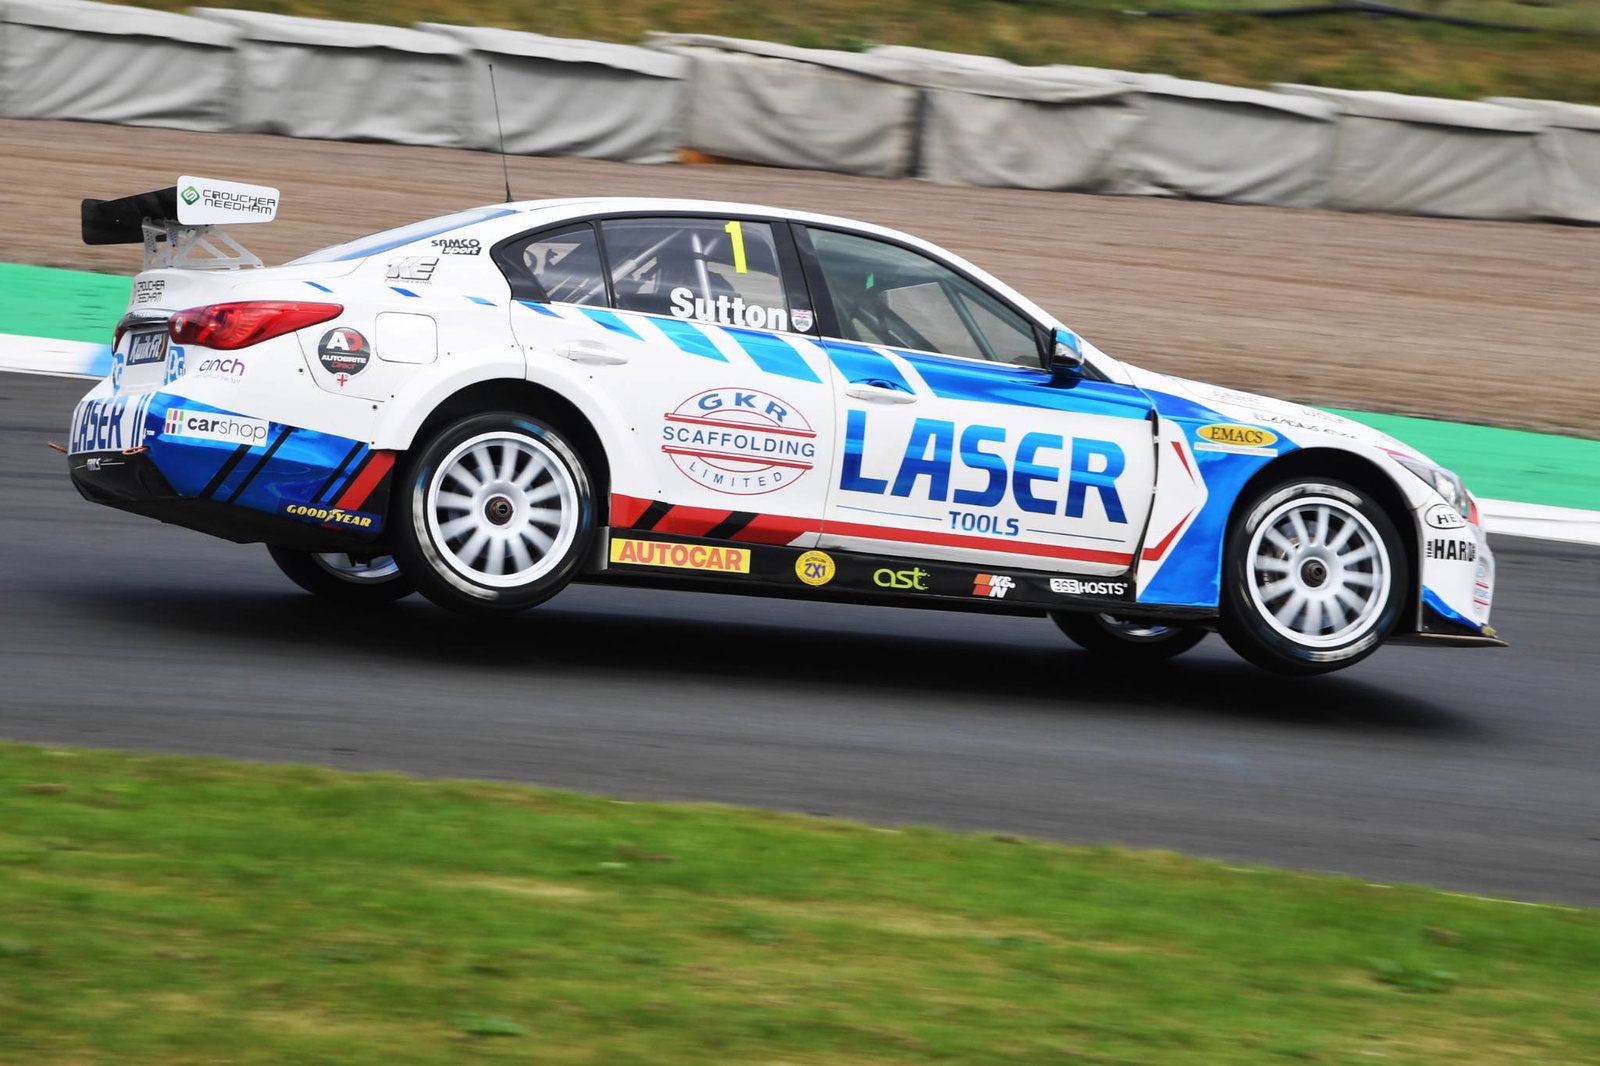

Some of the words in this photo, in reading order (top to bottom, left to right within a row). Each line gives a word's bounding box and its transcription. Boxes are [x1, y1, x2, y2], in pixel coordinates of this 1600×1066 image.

[202, 189, 276, 206] CROUCHER
[204, 198, 272, 215] NEEDHAM
[431, 238, 480, 248] SAMCO
[724, 221, 748, 274] 1
[670, 287, 788, 331] Sutton
[199, 358, 246, 376] cinch
[321, 354, 367, 364] AUTOBRITE
[698, 392, 788, 423] GKR
[71, 396, 128, 453] LASER
[187, 414, 267, 442] carshop
[1211, 426, 1264, 444] EMACS
[662, 426, 815, 458] SCAFFOLDING
[689, 461, 783, 488] LIMITED
[839, 409, 1128, 525] LASER
[949, 510, 1019, 537] TOOLS
[618, 540, 743, 571] AUTOCAR
[804, 562, 826, 578] ZX1
